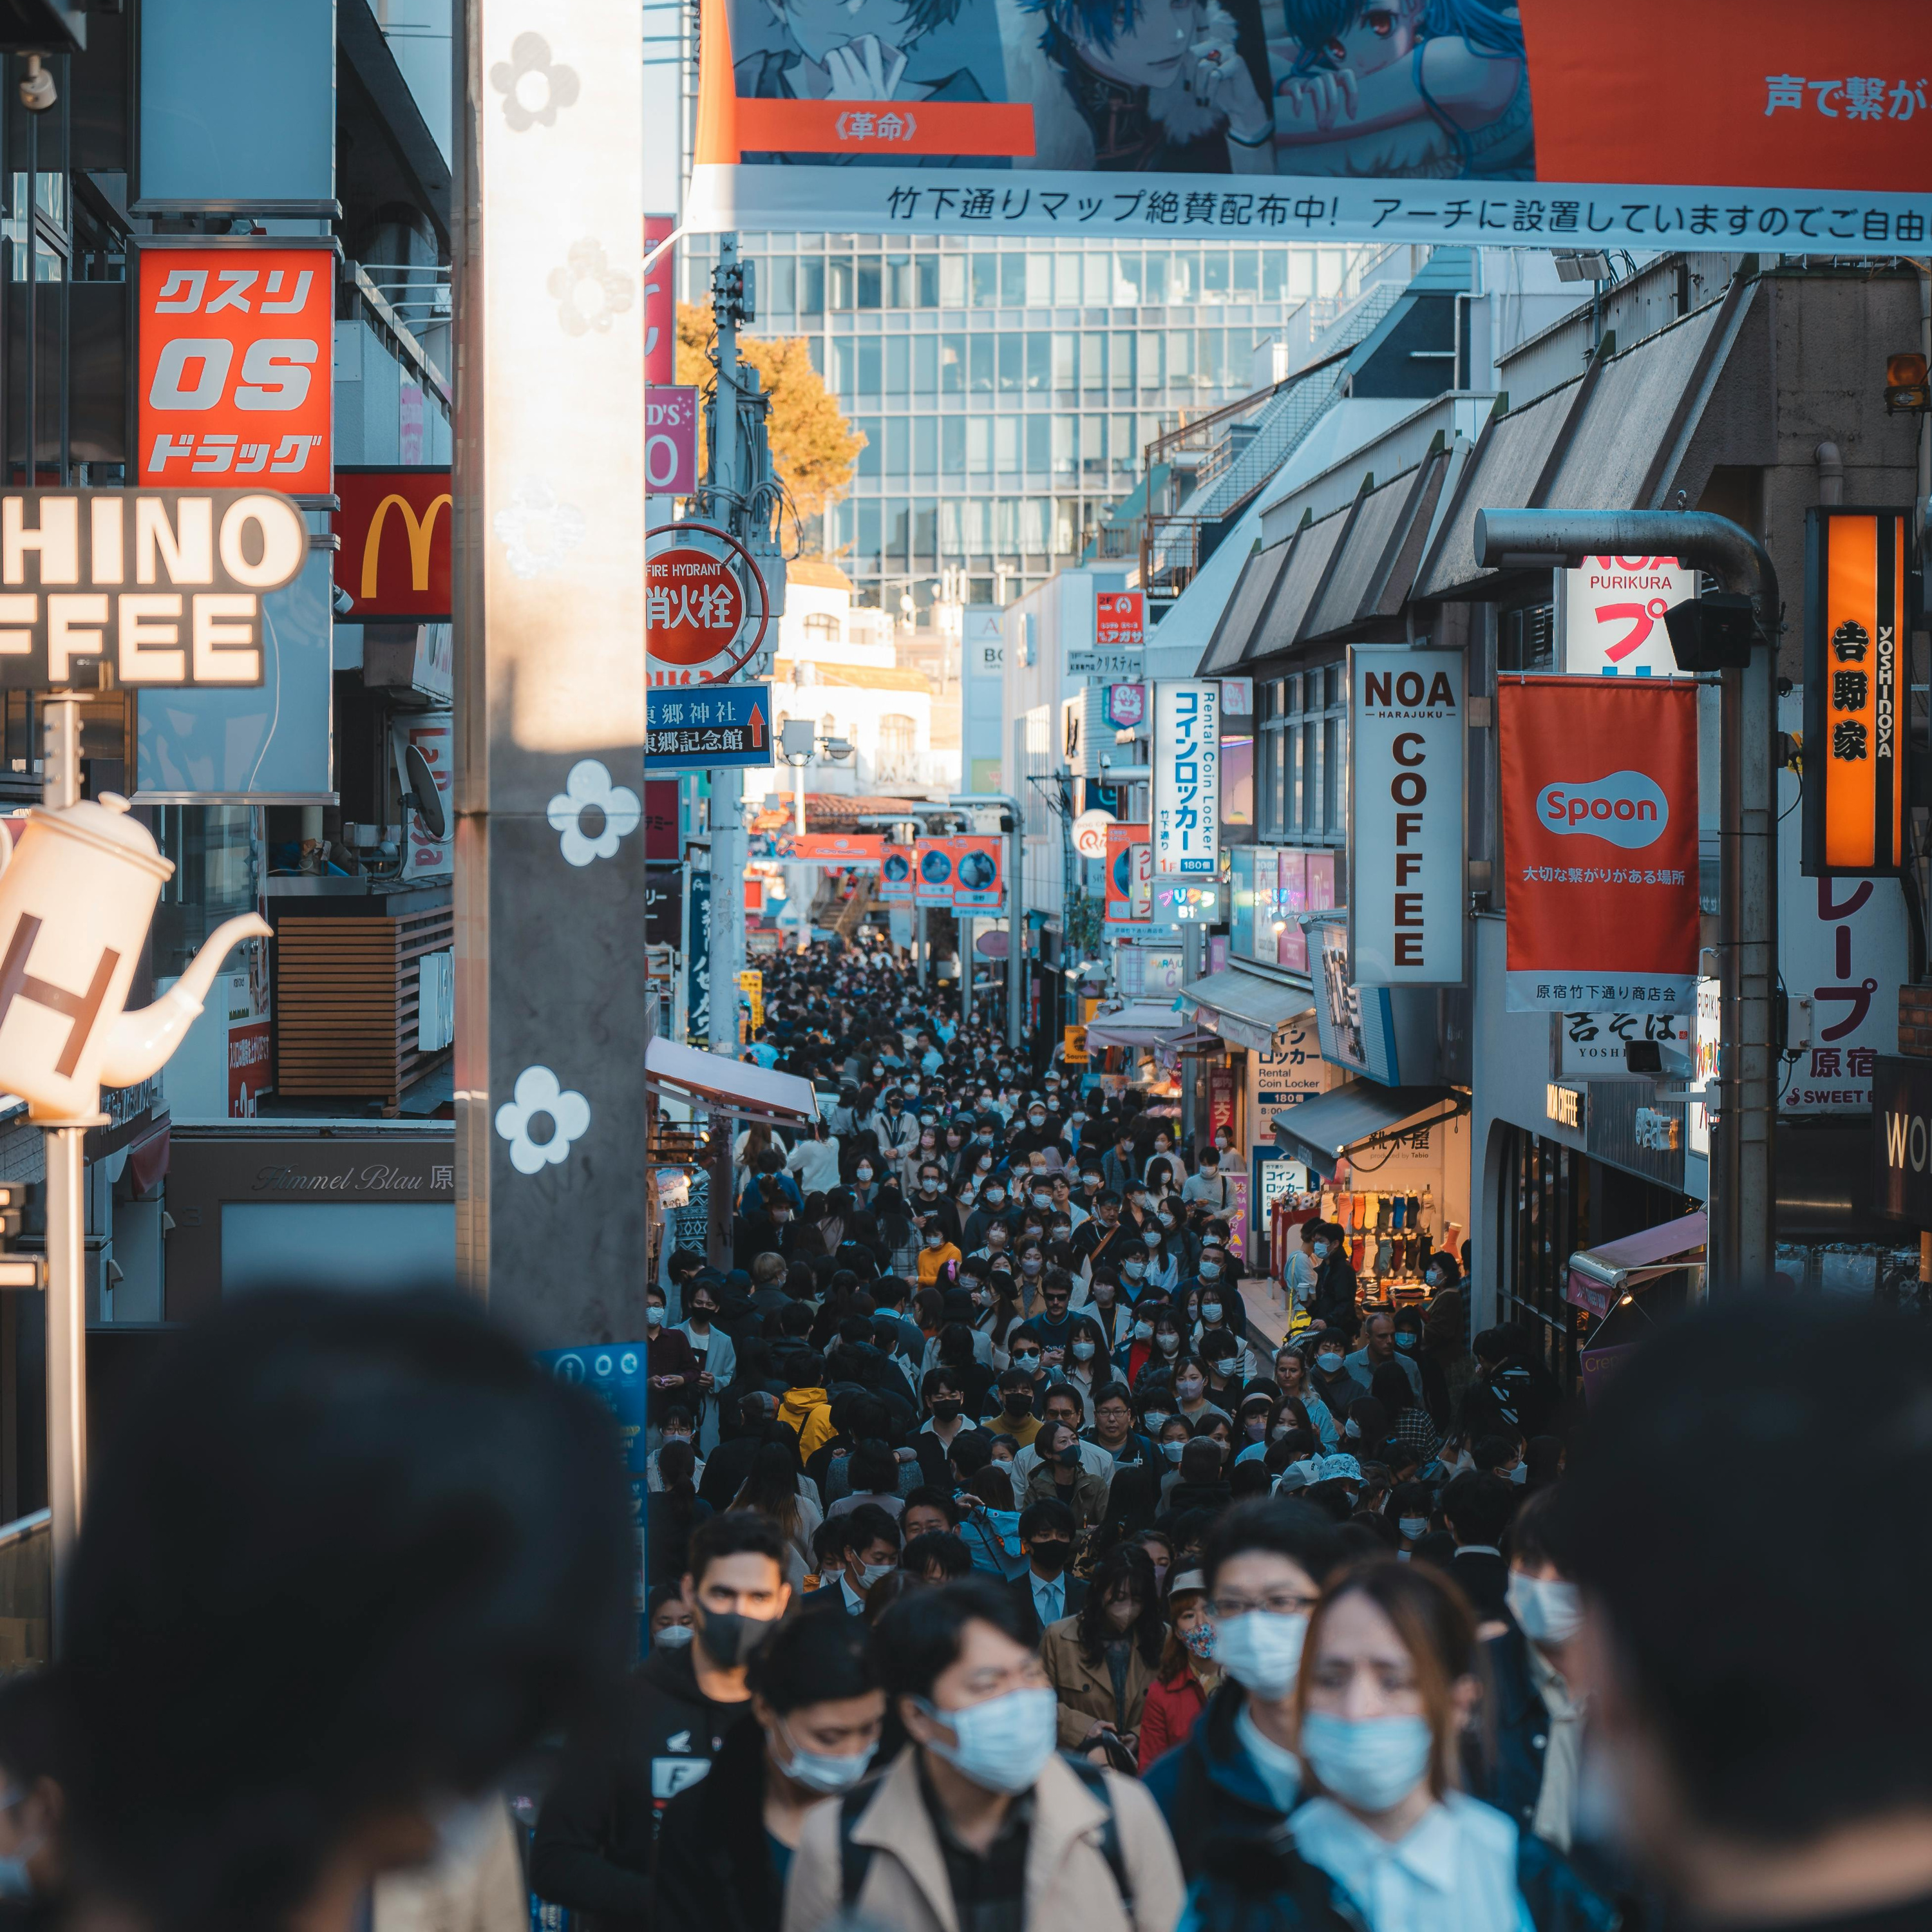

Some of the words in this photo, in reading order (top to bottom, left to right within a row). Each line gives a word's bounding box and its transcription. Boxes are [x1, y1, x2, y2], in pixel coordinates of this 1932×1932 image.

[1765, 73, 1929, 121] 声で繋が
[1372, 198, 1932, 242] アーチに設置していますのでご自由
[155, 270, 314, 314] クスリ
[149, 338, 319, 411] OS
[147, 434, 322, 473] ドラッグ
[2, 494, 303, 587] HINO
[645, 565, 668, 577] FIRE
[672, 564, 722, 576] HYDRANT
[1590, 576, 1672, 590] PURIKURA
[645, 583, 734, 630] 消火栓
[1096, 656, 1141, 672] クリスティー
[1365, 671, 1455, 708] NOA
[1833, 620, 1870, 762] 吉野家
[1878, 626, 1893, 757] YOSHINOYA
[1203, 692, 1215, 744] Rental
[1175, 692, 1198, 851] コインロッカー
[1203, 752, 1215, 789] Coin
[1203, 797, 1215, 852] Locker
[1548, 791, 1657, 826] Spoon
[1160, 810, 1170, 851] 竹下通り
[1390, 732, 1427, 966] COFFEE
[1184, 861, 1211, 869] 180個
[1522, 866, 1686, 886] 大切な繋がりがある場所
[1536, 985, 1676, 1002] 原宿竹下通り商店会
[1698, 994, 1721, 1021] PURIKU
[1259, 1068, 1291, 1077] Rental
[1810, 1046, 1878, 1078] 原宿
[1259, 1079, 1282, 1088] Coin
[1285, 1079, 1320, 1088] Locker
[1274, 1094, 1304, 1103] 180個
[1804, 1090, 1864, 1104] SWEET
[1885, 1111, 1932, 1173] WO
[355, 1164, 424, 1191] Blau
[1266, 1171, 1296, 1181] コイン
[1266, 1184, 1304, 1193] ロッカー
